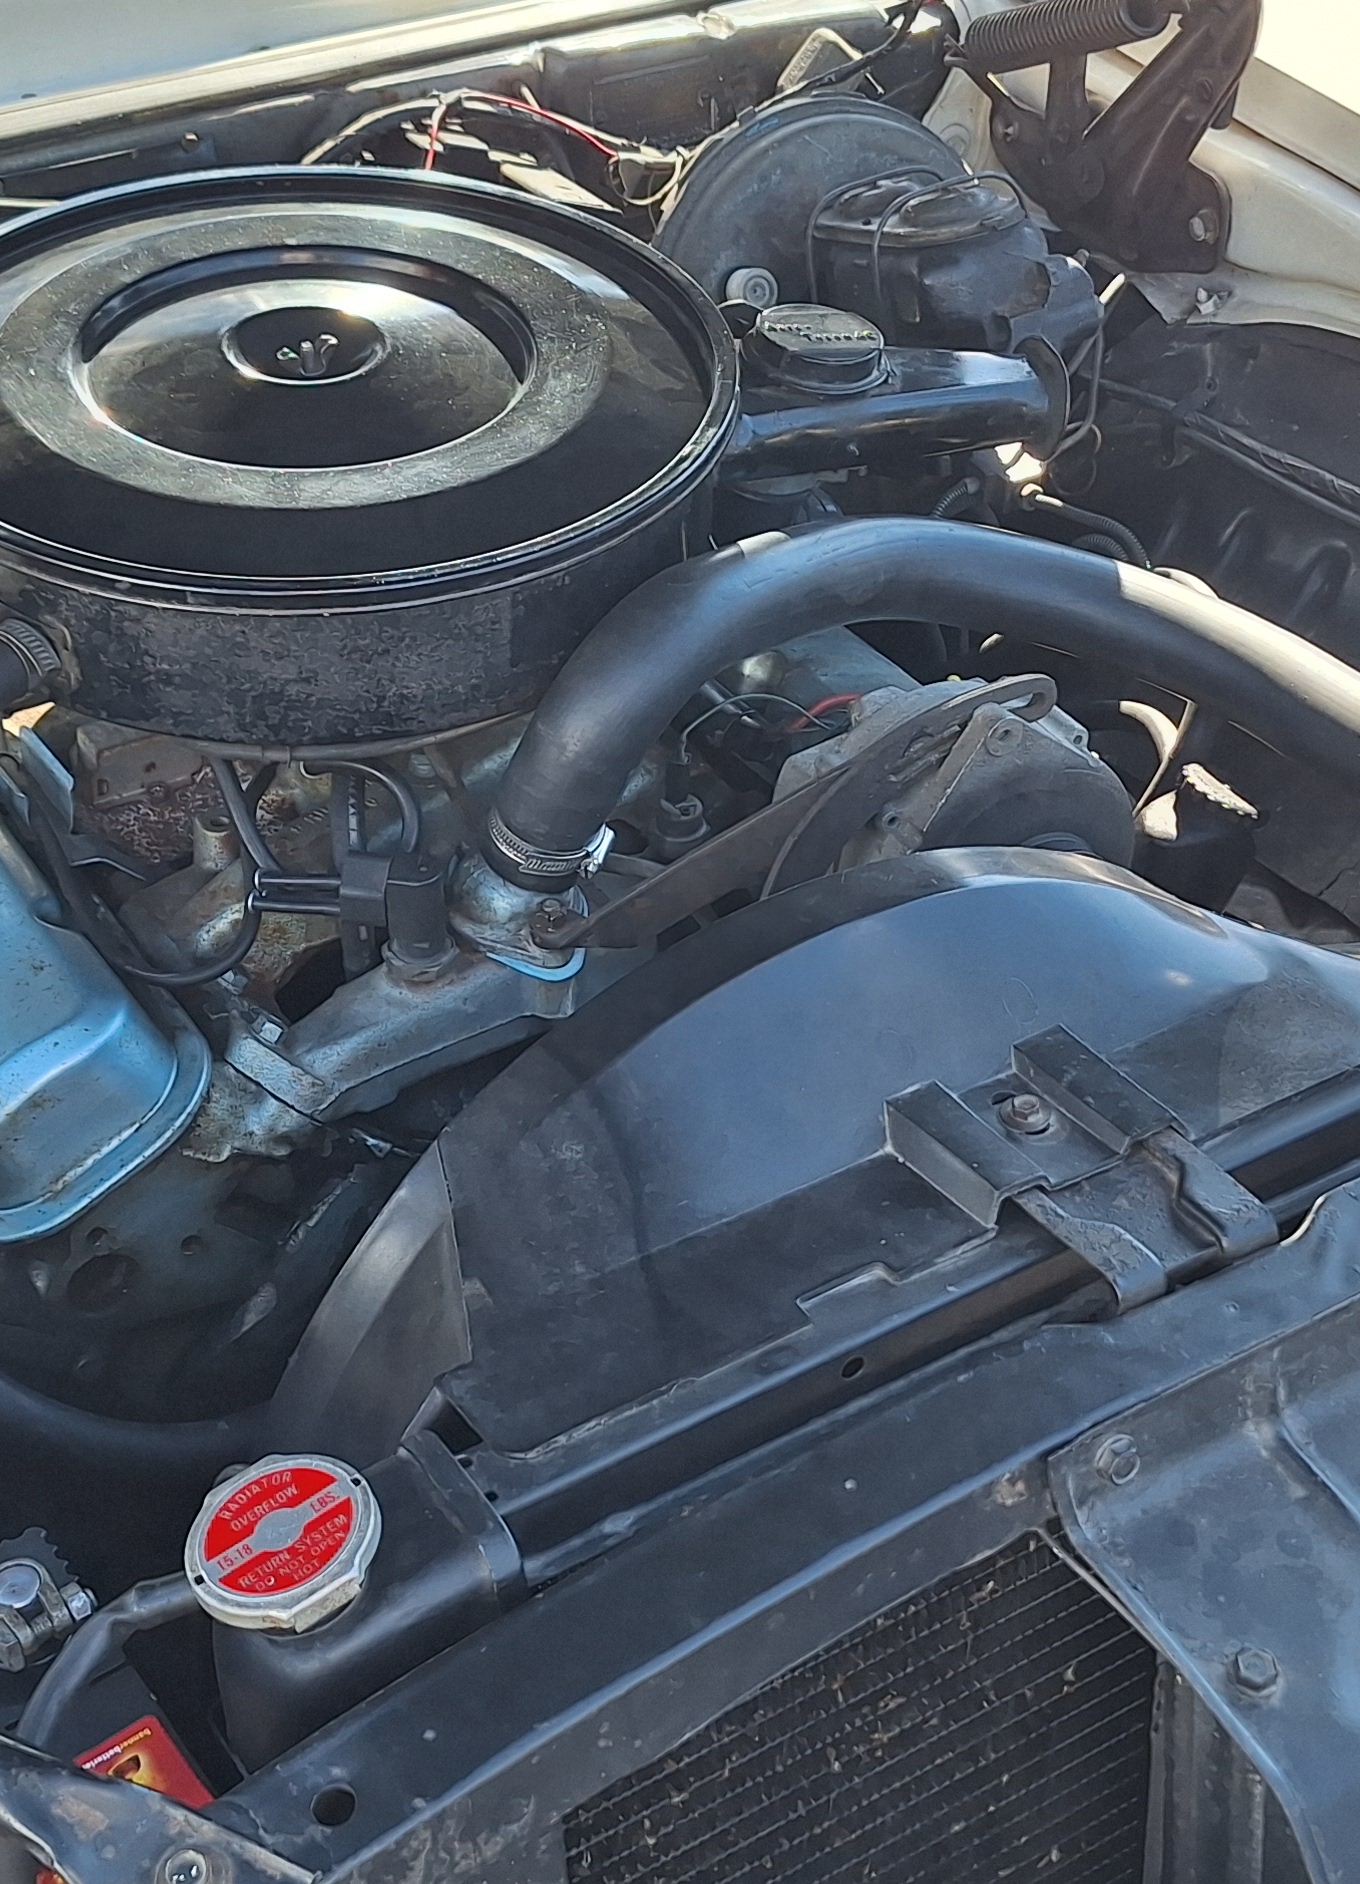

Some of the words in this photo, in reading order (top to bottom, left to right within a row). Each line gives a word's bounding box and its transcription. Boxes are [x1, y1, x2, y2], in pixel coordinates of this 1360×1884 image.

[218, 1471, 292, 1521] RADIATOR
[230, 1484, 299, 1532] OVERFLOW
[217, 1543, 253, 1571] 15-18
[238, 1552, 291, 1590] RETURN
[294, 1514, 348, 1554] SYSTEM
[255, 1575, 275, 1592] DO
[279, 1553, 305, 1577] NOT
[310, 1530, 346, 1557] OPEN
[292, 1559, 321, 1582] HOT
